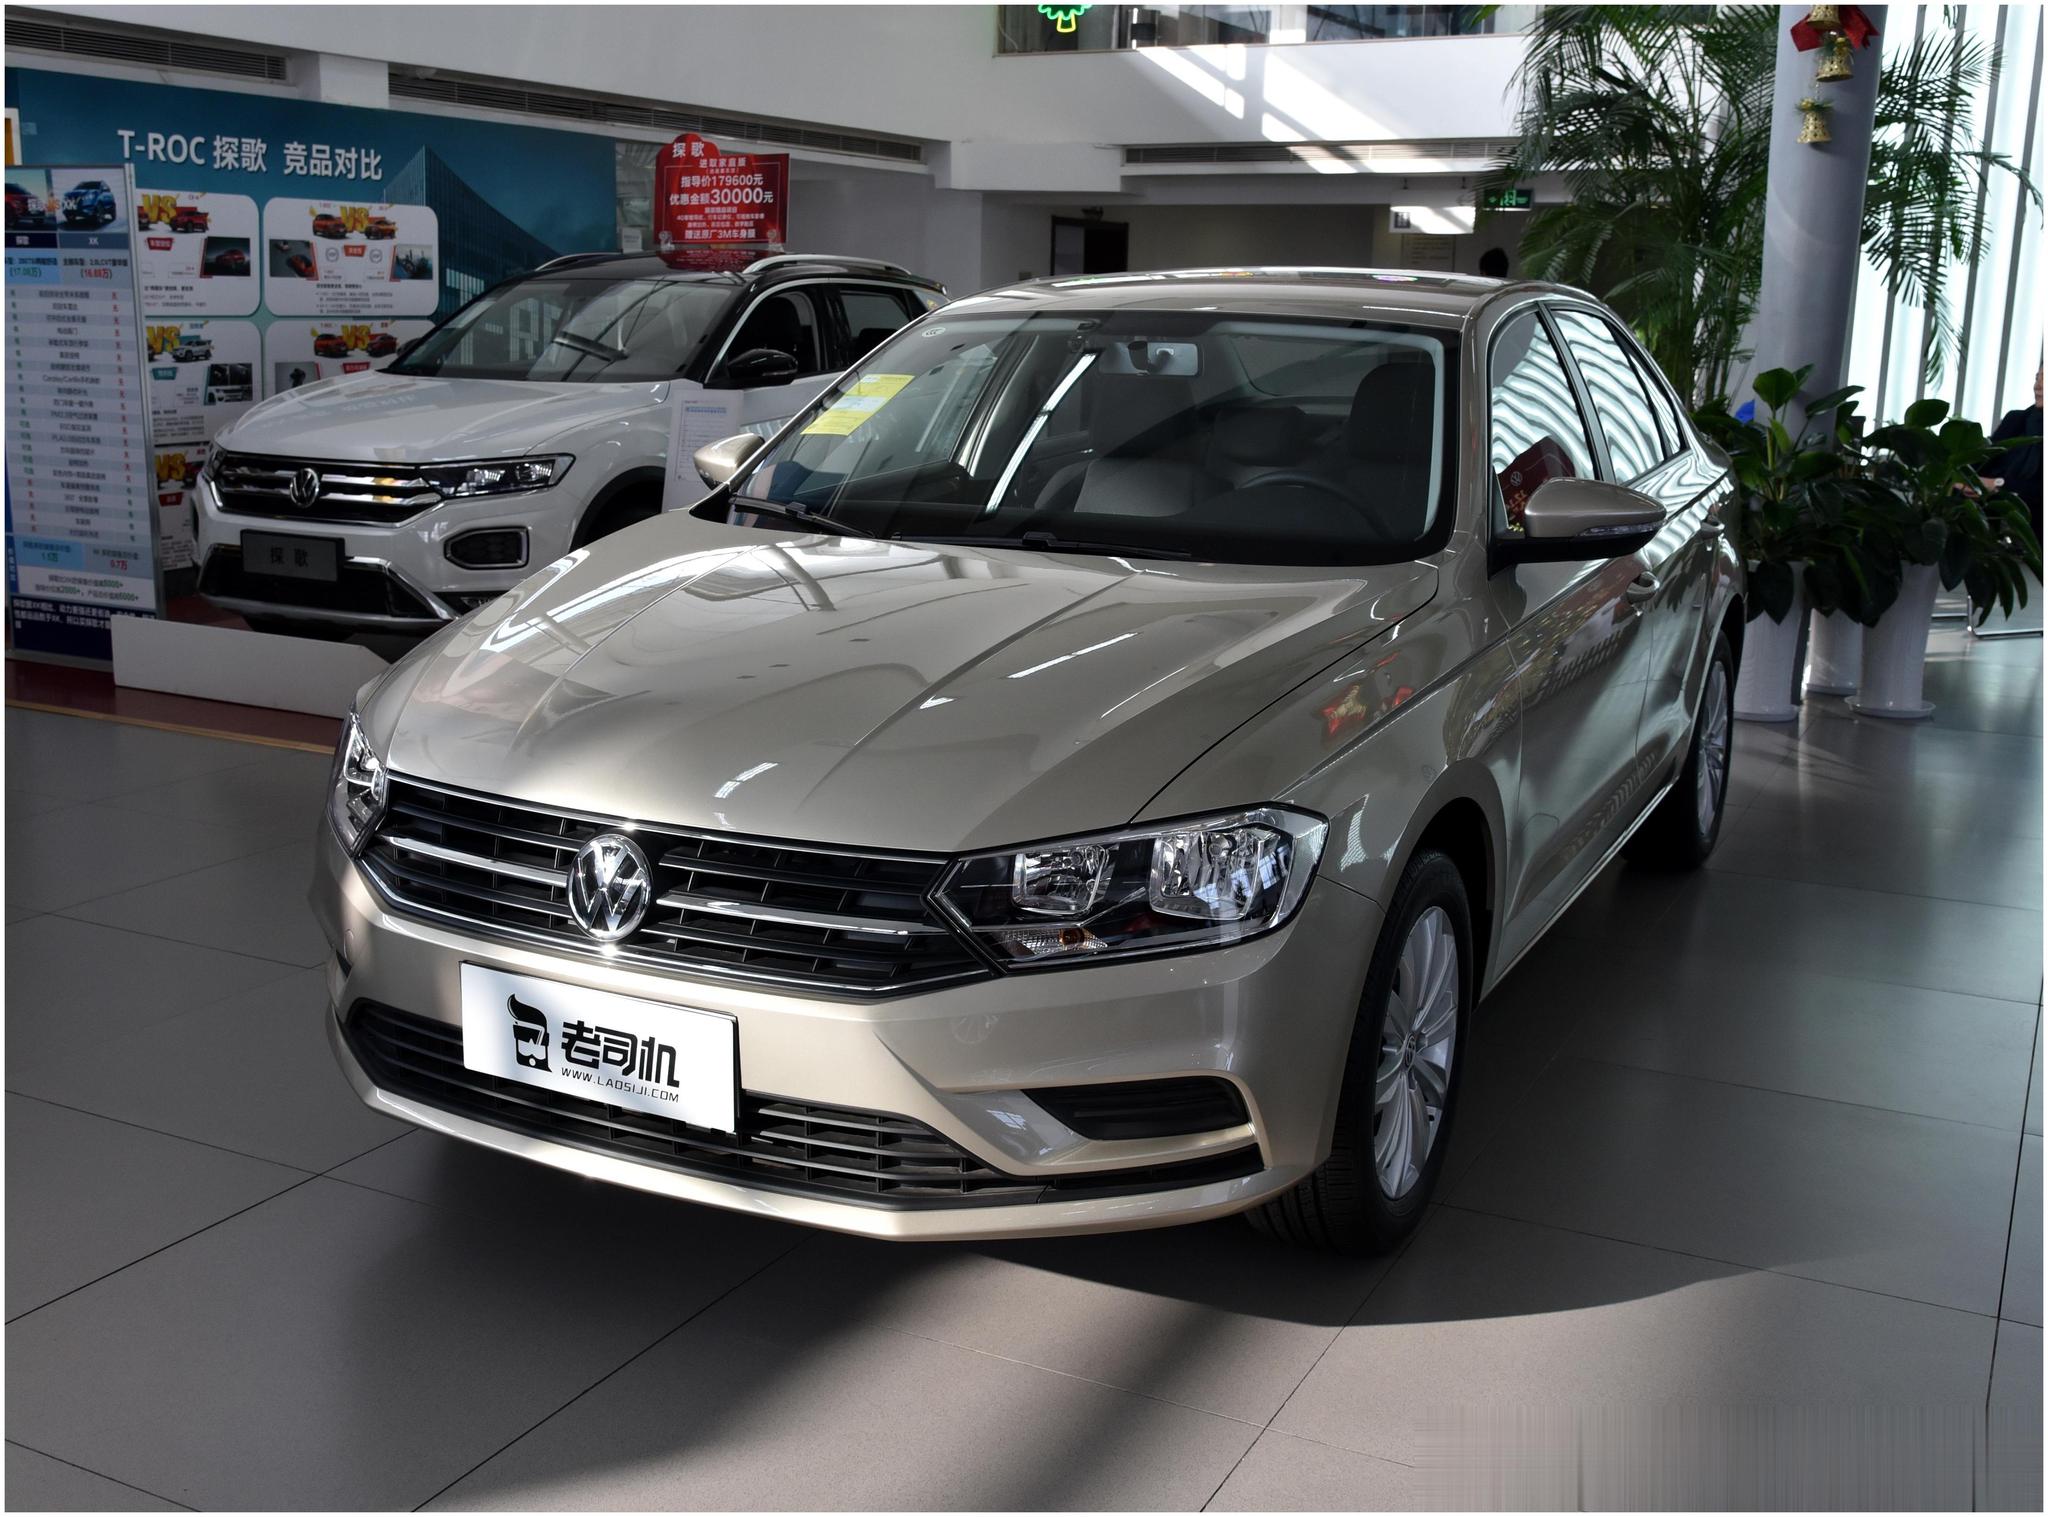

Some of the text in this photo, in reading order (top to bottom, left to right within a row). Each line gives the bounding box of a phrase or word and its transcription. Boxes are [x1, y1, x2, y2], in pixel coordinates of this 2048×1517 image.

[117, 129, 382, 180] T-ROC 探歌 竞品对比
[672, 142, 705, 158] 探歌
[681, 173, 764, 188] 指导价179600元
[141, 194, 177, 224] VS
[669, 188, 774, 205] 优惠金额30000元
[340, 206, 369, 232] VS
[146, 326, 180, 355] VS
[341, 324, 370, 350] VS
[155, 453, 187, 481] VS
[561, 1019, 680, 1088] 老司机
[560, 1066, 680, 1103] WWW.LAOSIJI.COM
